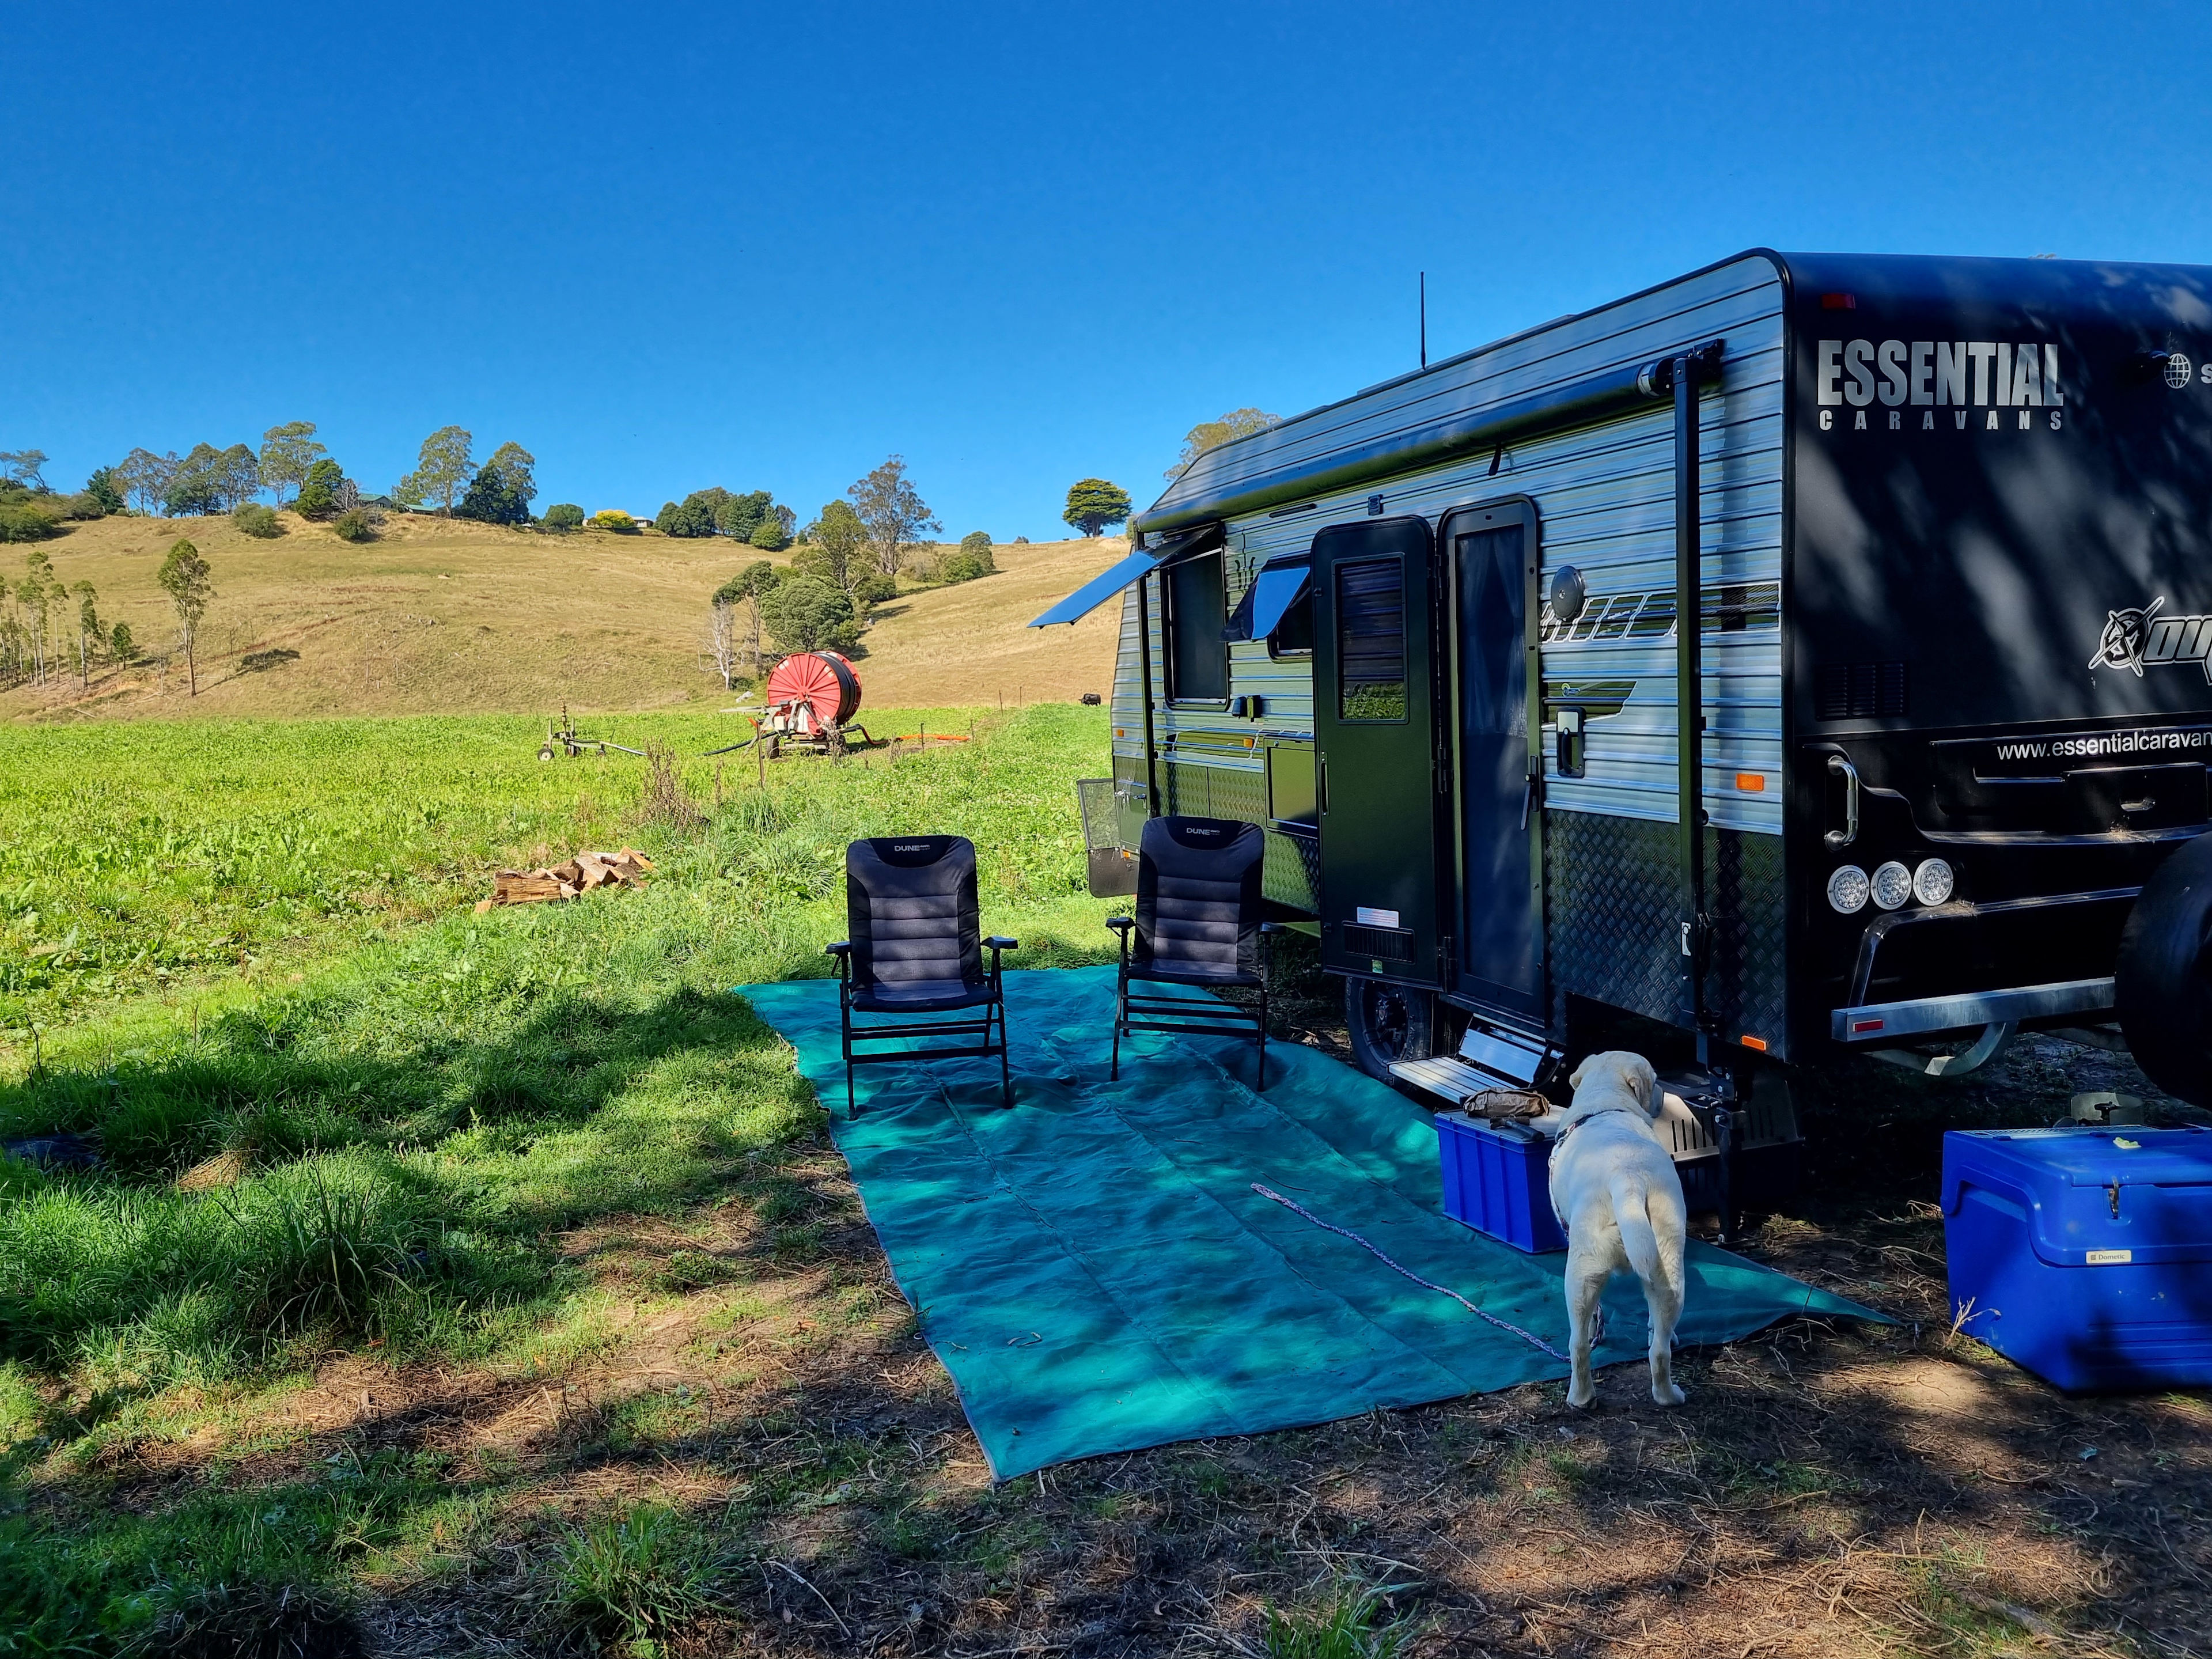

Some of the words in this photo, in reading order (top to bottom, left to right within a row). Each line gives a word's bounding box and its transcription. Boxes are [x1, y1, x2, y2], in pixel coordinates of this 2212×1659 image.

[1817, 339, 2064, 407] ESSENTIAL
[1819, 410, 2062, 430] CARAVANS
[1186, 827, 1210, 835] DUNE
